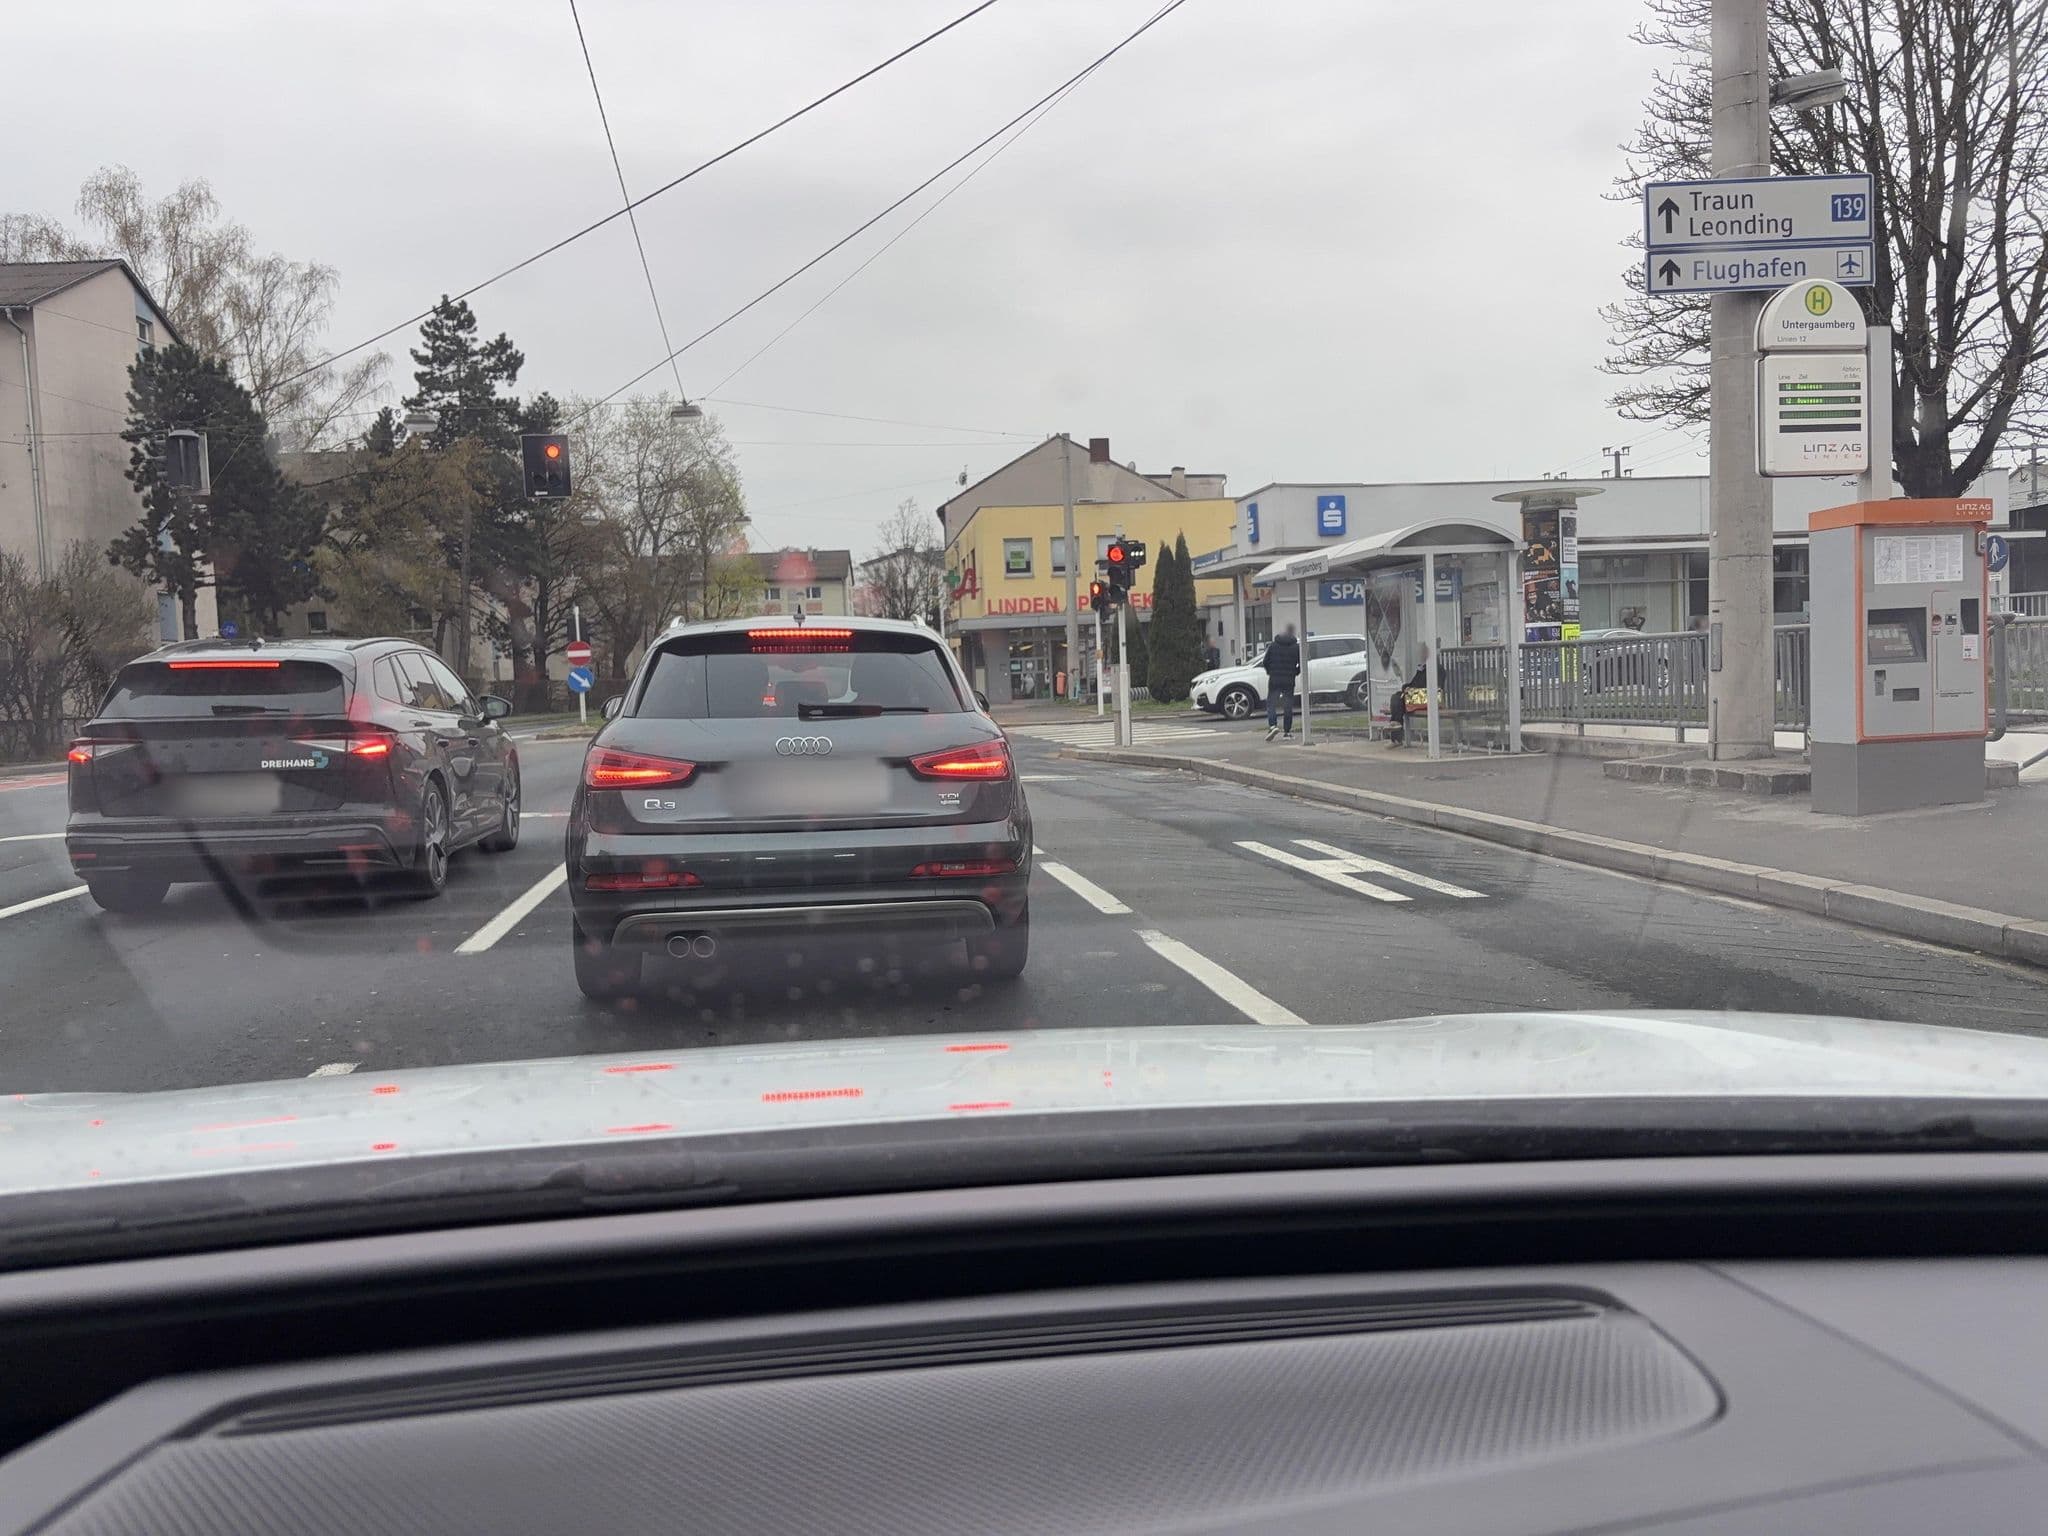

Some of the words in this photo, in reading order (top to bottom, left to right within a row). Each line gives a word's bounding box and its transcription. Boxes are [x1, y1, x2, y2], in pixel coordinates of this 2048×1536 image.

[1689, 191, 1754, 212] Traun
[1833, 196, 1864, 219] 139
[1689, 213, 1794, 238] Leonding
[1693, 257, 1807, 284] Flughafen
[1812, 292, 1825, 310] H
[1782, 320, 1856, 331] Untergaumberg
[1840, 443, 1862, 452] AG
[1978, 503, 1991, 511] AG
[987, 597, 1060, 615] LINDEN
[261, 758, 315, 769] DREIHANS
[644, 798, 676, 810] Q3
